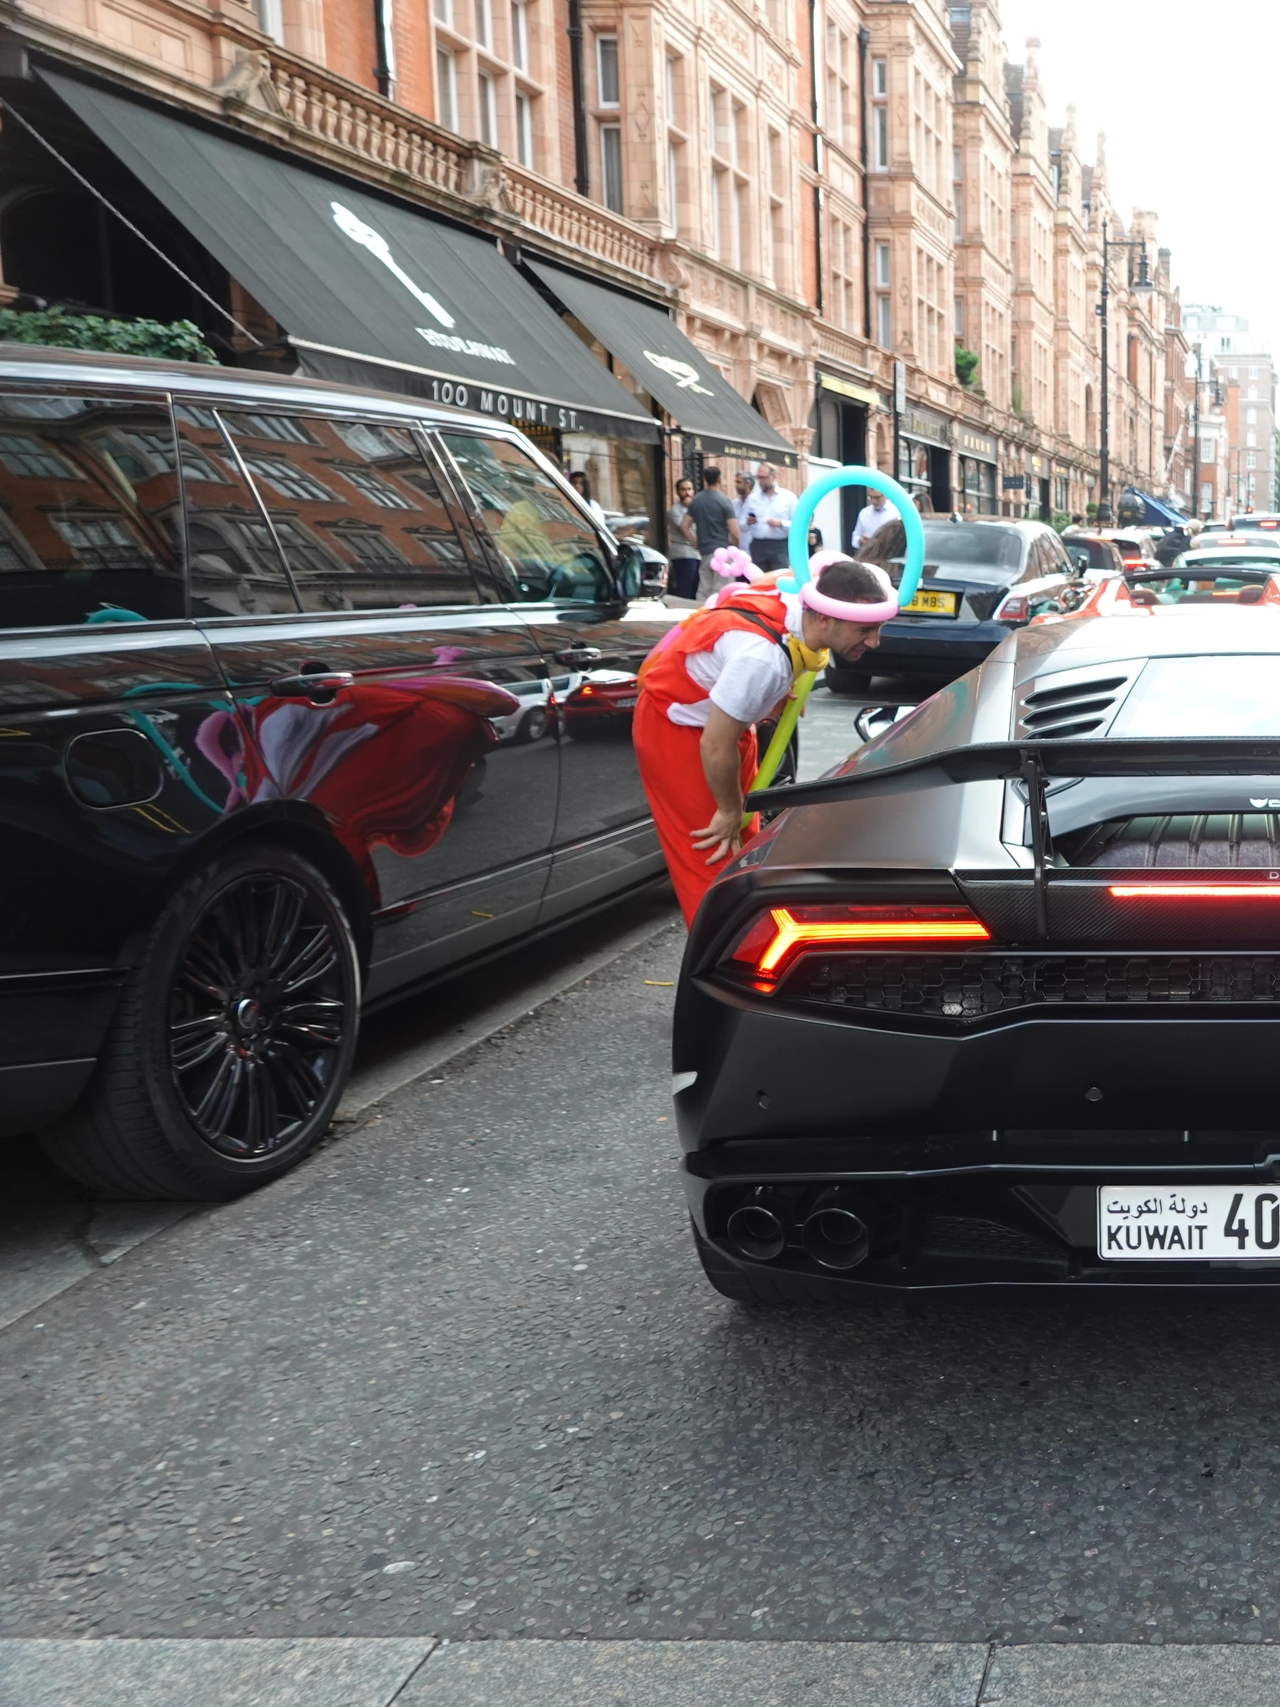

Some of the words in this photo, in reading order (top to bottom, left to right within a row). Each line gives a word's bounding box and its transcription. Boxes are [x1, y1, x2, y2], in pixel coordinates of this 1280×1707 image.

[431, 379, 468, 407] 100
[480, 390, 548, 423] MOUNT
[1106, 1196, 1163, 1221] الكويت
[1168, 1193, 1208, 1219] دولة
[1106, 1225, 1208, 1251] KUWAIT
